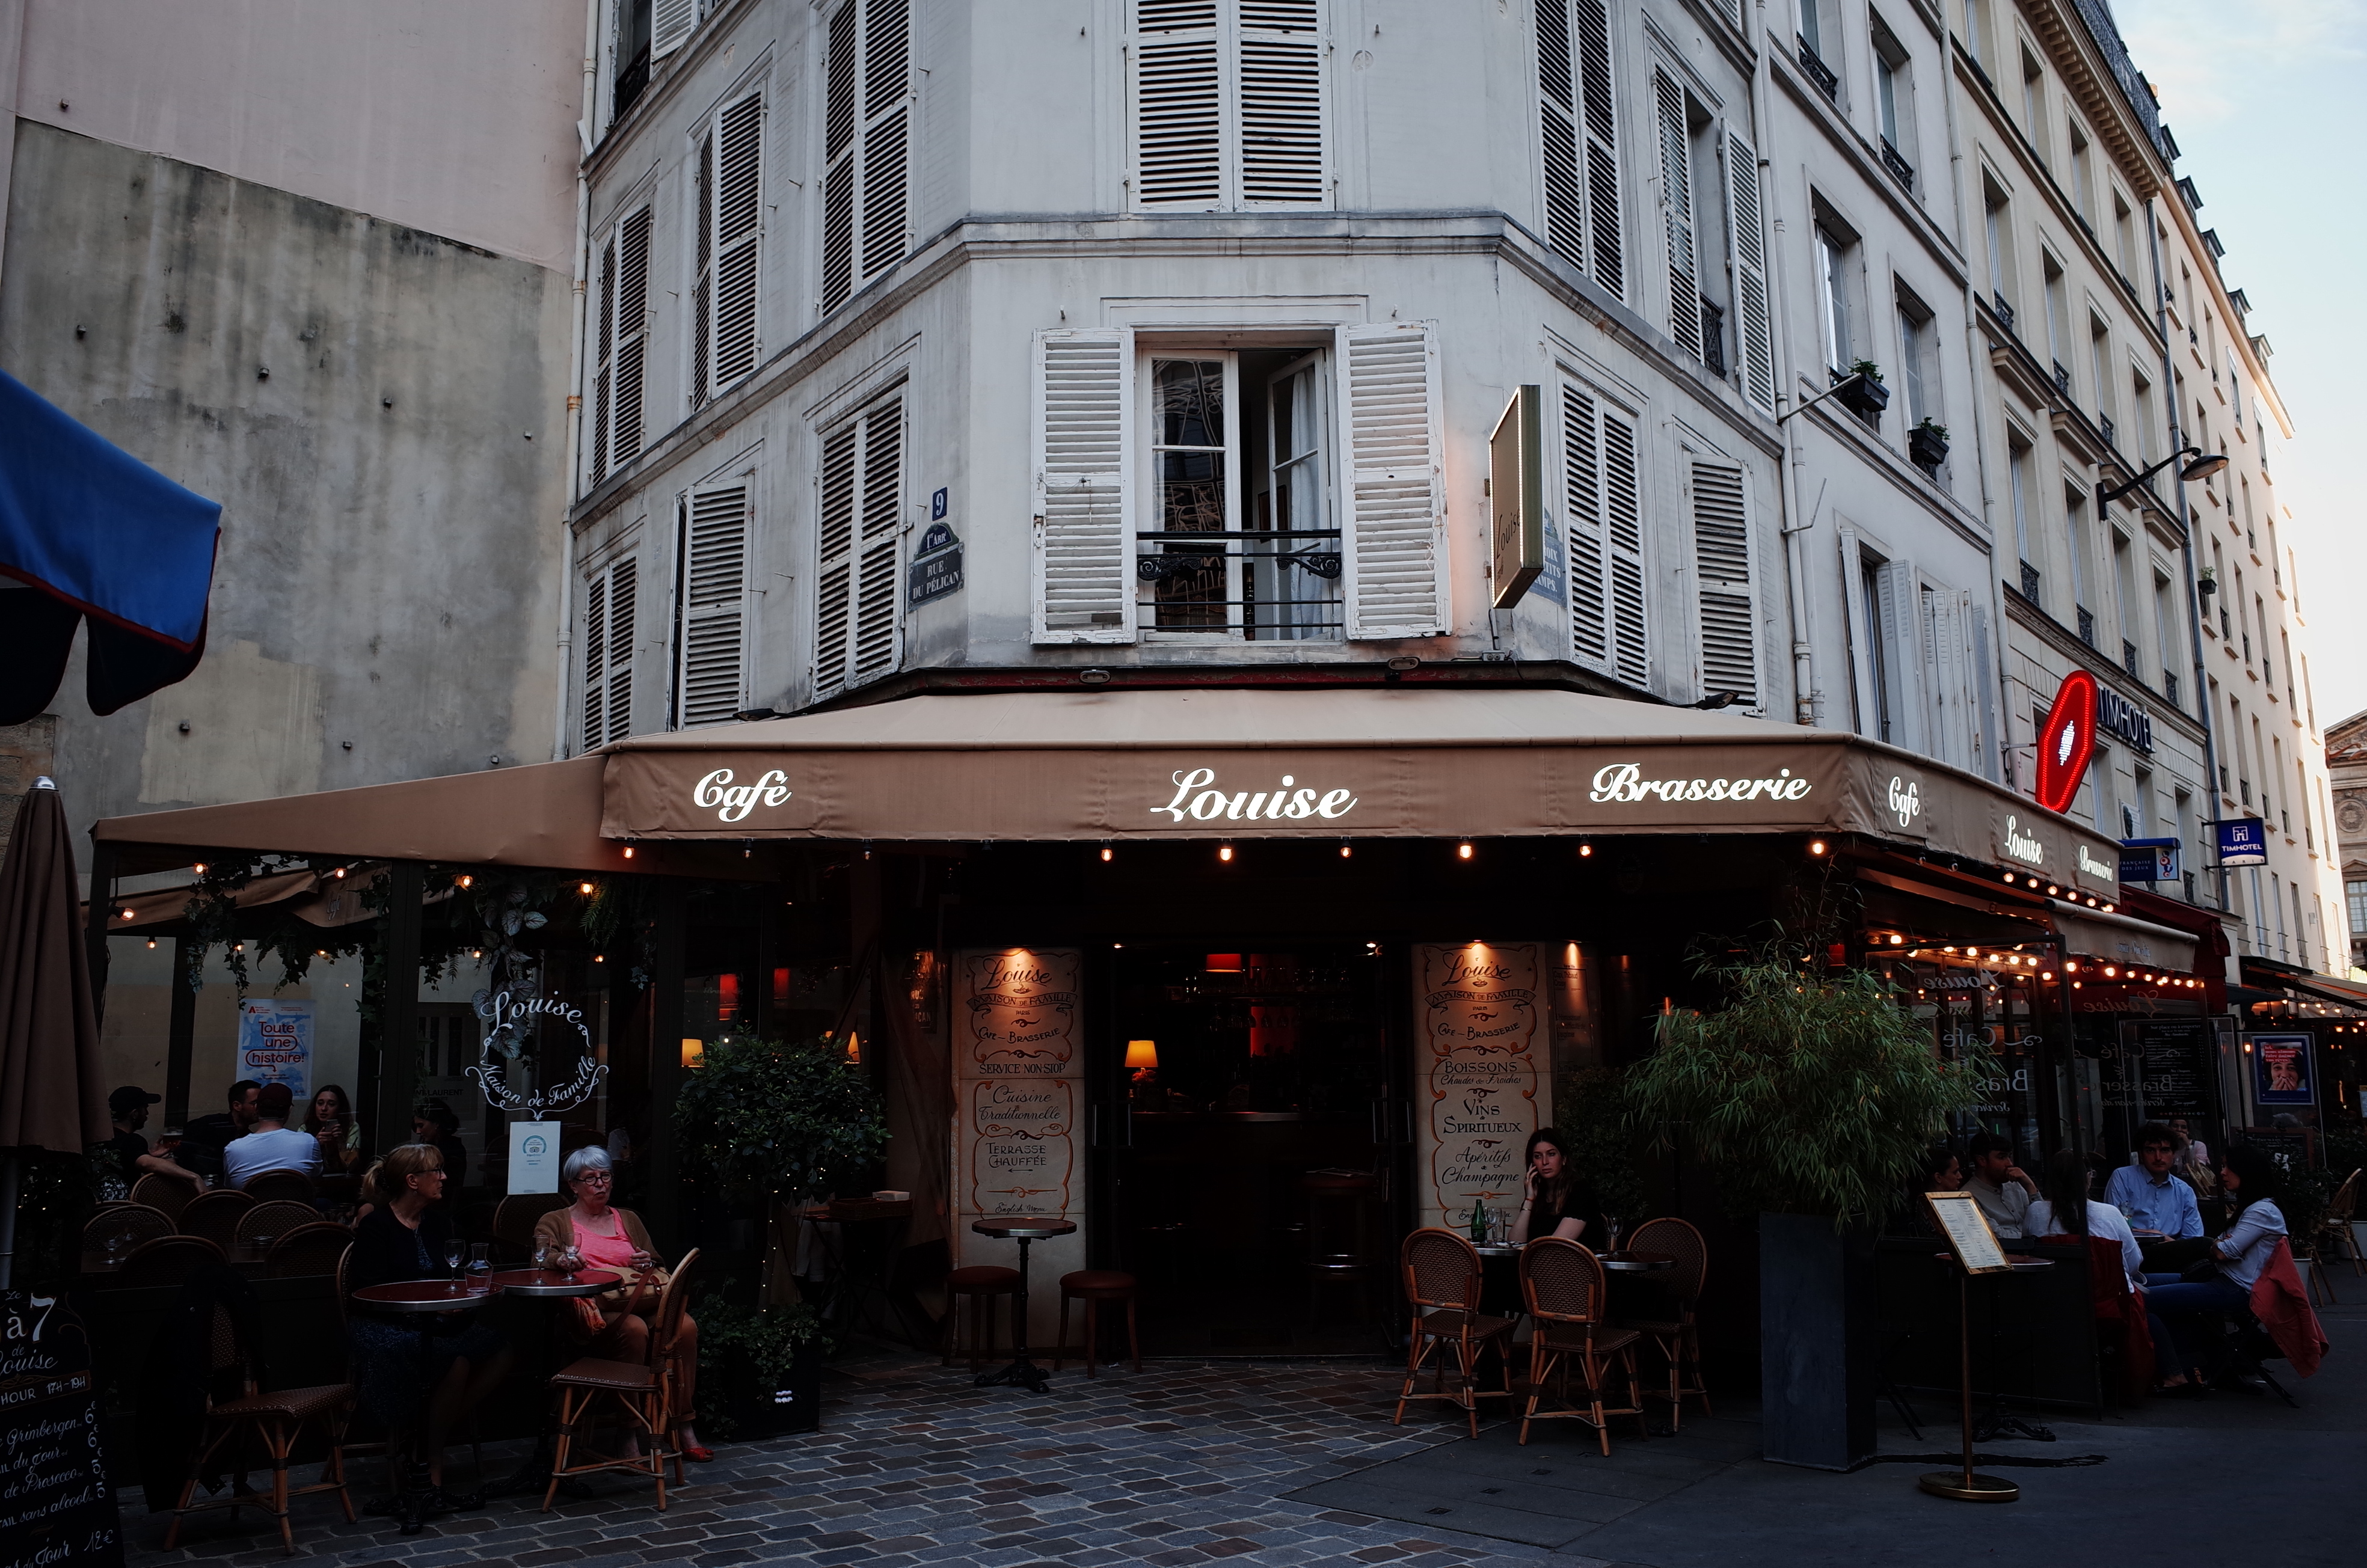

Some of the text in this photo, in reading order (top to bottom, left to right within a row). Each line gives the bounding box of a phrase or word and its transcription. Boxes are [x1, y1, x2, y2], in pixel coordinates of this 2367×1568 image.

[936, 492, 944, 516] 9
[1544, 548, 1558, 562] OIX
[927, 560, 944, 577] RUE
[913, 570, 959, 599] DU PÉLICAN
[1589, 762, 1813, 803] Brasserie
[693, 768, 793, 822] Café
[1149, 767, 1358, 822] Louise
[1888, 776, 1921, 828] Café
[2004, 815, 2043, 865] Louise
[2221, 844, 2262, 853] TIMHOTEL
[2080, 845, 2113, 882] Brasserie
[980, 958, 1052, 991] Louise
[1441, 952, 1512, 987] Louise
[973, 994, 1016, 1006] MAISON
[1029, 994, 1071, 1005] FAMILLE
[1431, 991, 1475, 1003] MAISON
[1486, 990, 1529, 1000] FAMILLE
[480, 991, 582, 1036] Louise
[259, 1021, 295, 1034] Toute
[1007, 1027, 1060, 1044] BRASSERIE
[1466, 1022, 1520, 1040] BRASSERIE
[265, 1039, 291, 1047] une
[253, 1052, 304, 1063] histoire!
[979, 1062, 1066, 1074] SERVICE NON-STOP
[1444, 1061, 1518, 1073] BOISSONS
[480, 1055, 596, 1107] Maison de Famille
[1440, 1074, 1474, 1085] Chaudes
[993, 1085, 1052, 1104] Cuisine
[978, 1106, 1061, 1121] Traditionnelle
[1463, 1098, 1500, 1115] VINS
[1443, 1115, 1523, 1133] SPIRITUEUX
[985, 1142, 1046, 1154] TERRASSE
[989, 1155, 1047, 1168] CHAUFFÉE
[1455, 1147, 1511, 1170] Apéritifs
[1441, 1167, 1520, 1189] Champagne
[995, 1202, 1047, 1215] English Menu
[5, 1290, 23, 1301] Le
[7, 1292, 57, 1343] à 7
[11, 1344, 26, 1356] de
[1, 1388, 36, 1406] HOUR
[7, 1419, 77, 1455] Grimbergen
[13, 1451, 29, 1470] du
[4, 1481, 19, 1499] de
[22, 1469, 77, 1493] Prosecco
[19, 1505, 46, 1522] sans
[51, 1485, 90, 1513] alcool
